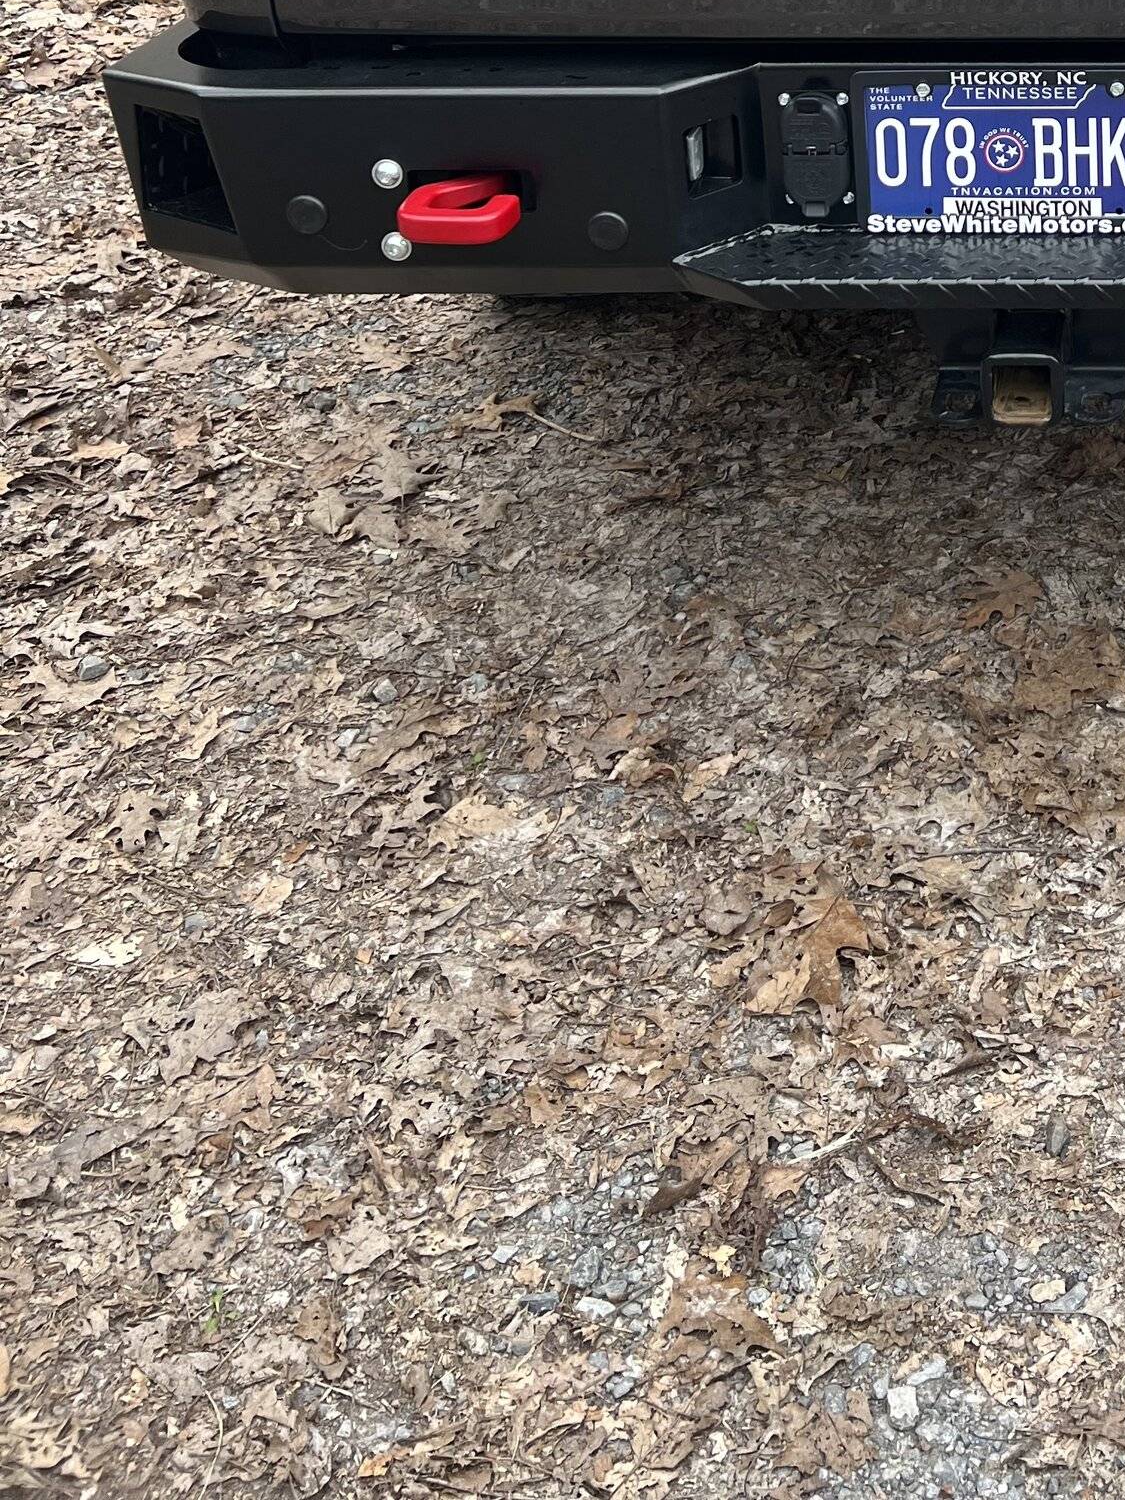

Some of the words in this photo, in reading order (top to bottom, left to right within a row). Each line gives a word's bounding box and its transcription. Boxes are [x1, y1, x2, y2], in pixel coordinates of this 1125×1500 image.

[950, 71, 1047, 86] HICKORY,
[1057, 71, 1087, 85] NC
[962, 87, 1078, 100] TENNESSEE
[870, 103, 903, 111] STATE
[875, 117, 977, 187] 078
[951, 187, 1096, 196] TNVACATION.COM
[955, 200, 1092, 218] WASHINGTON
